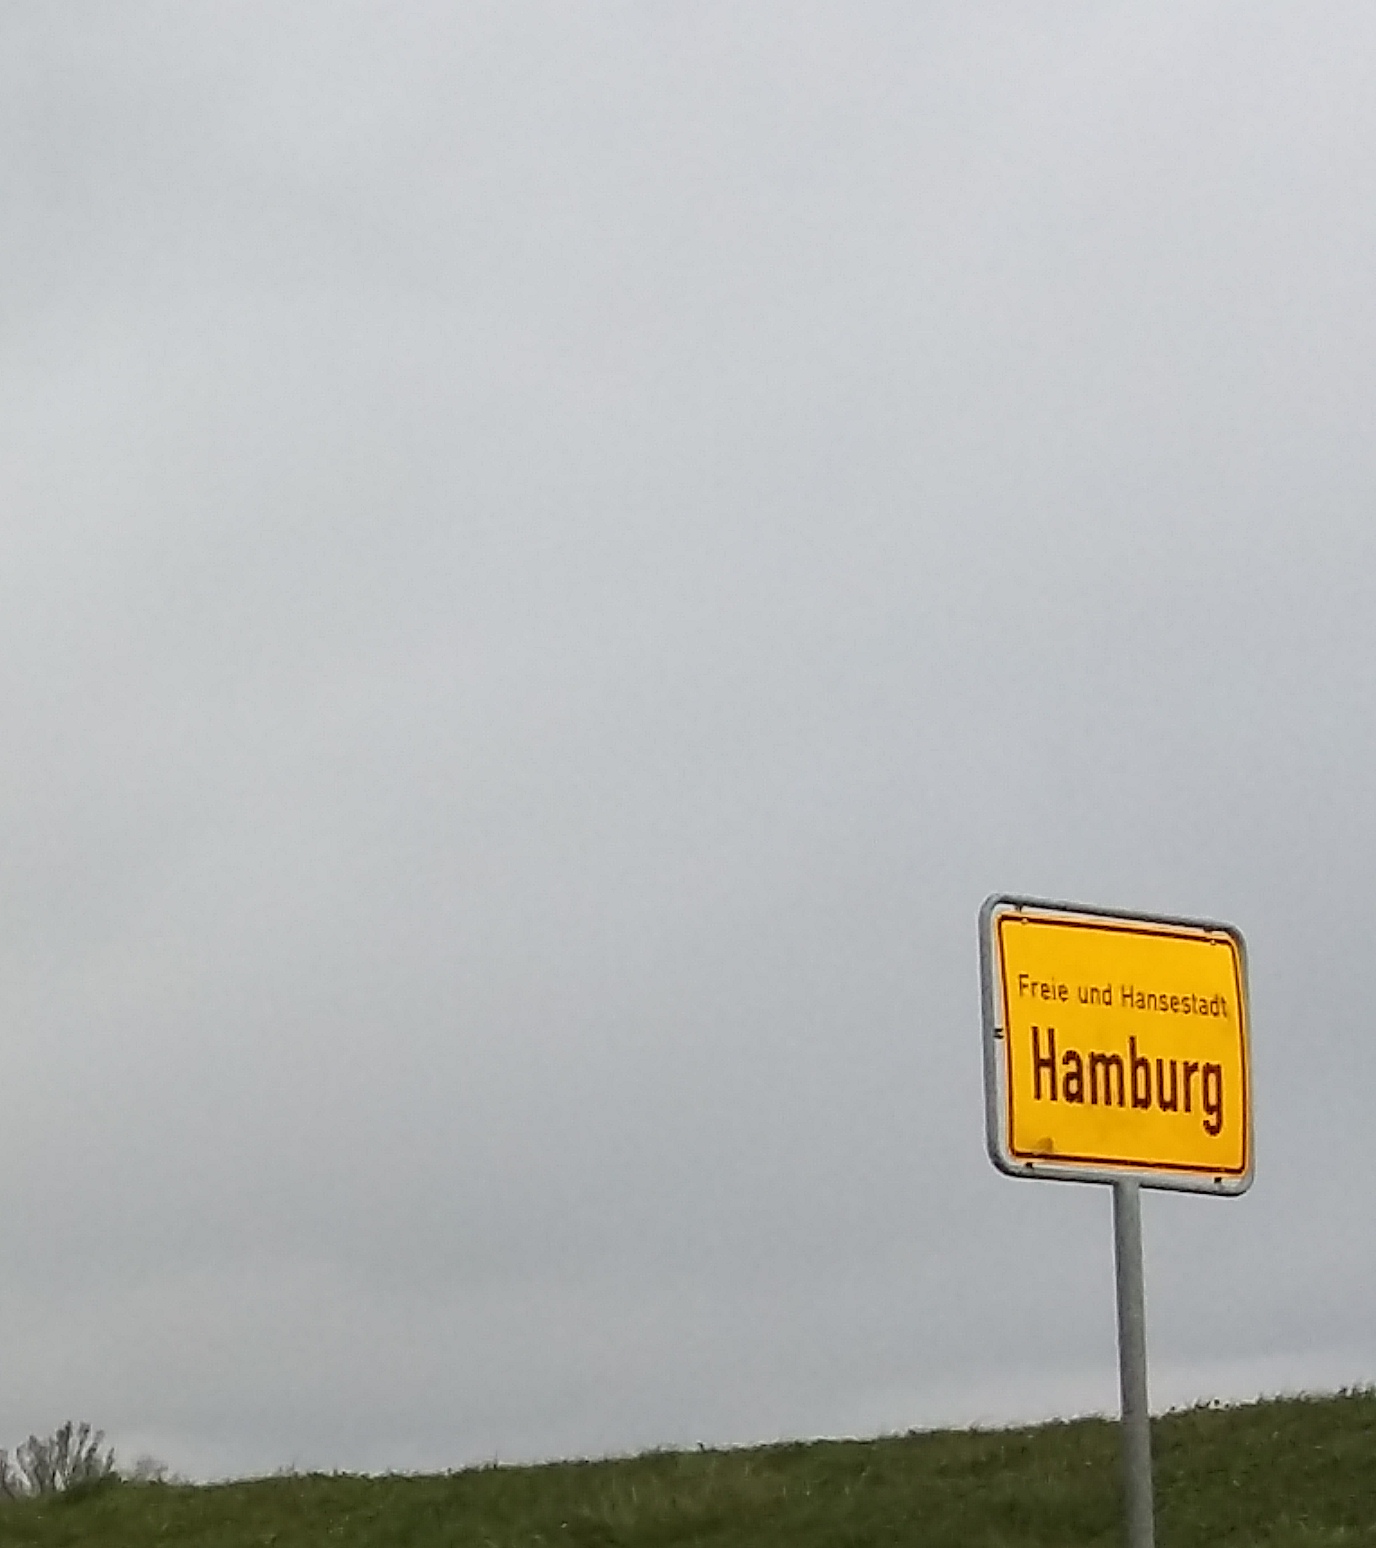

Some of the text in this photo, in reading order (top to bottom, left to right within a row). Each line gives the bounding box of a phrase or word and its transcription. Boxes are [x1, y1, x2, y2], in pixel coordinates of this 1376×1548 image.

[1018, 973, 1228, 1018] Freie und Hansestadt
[1031, 1025, 1223, 1137] Hamburg
